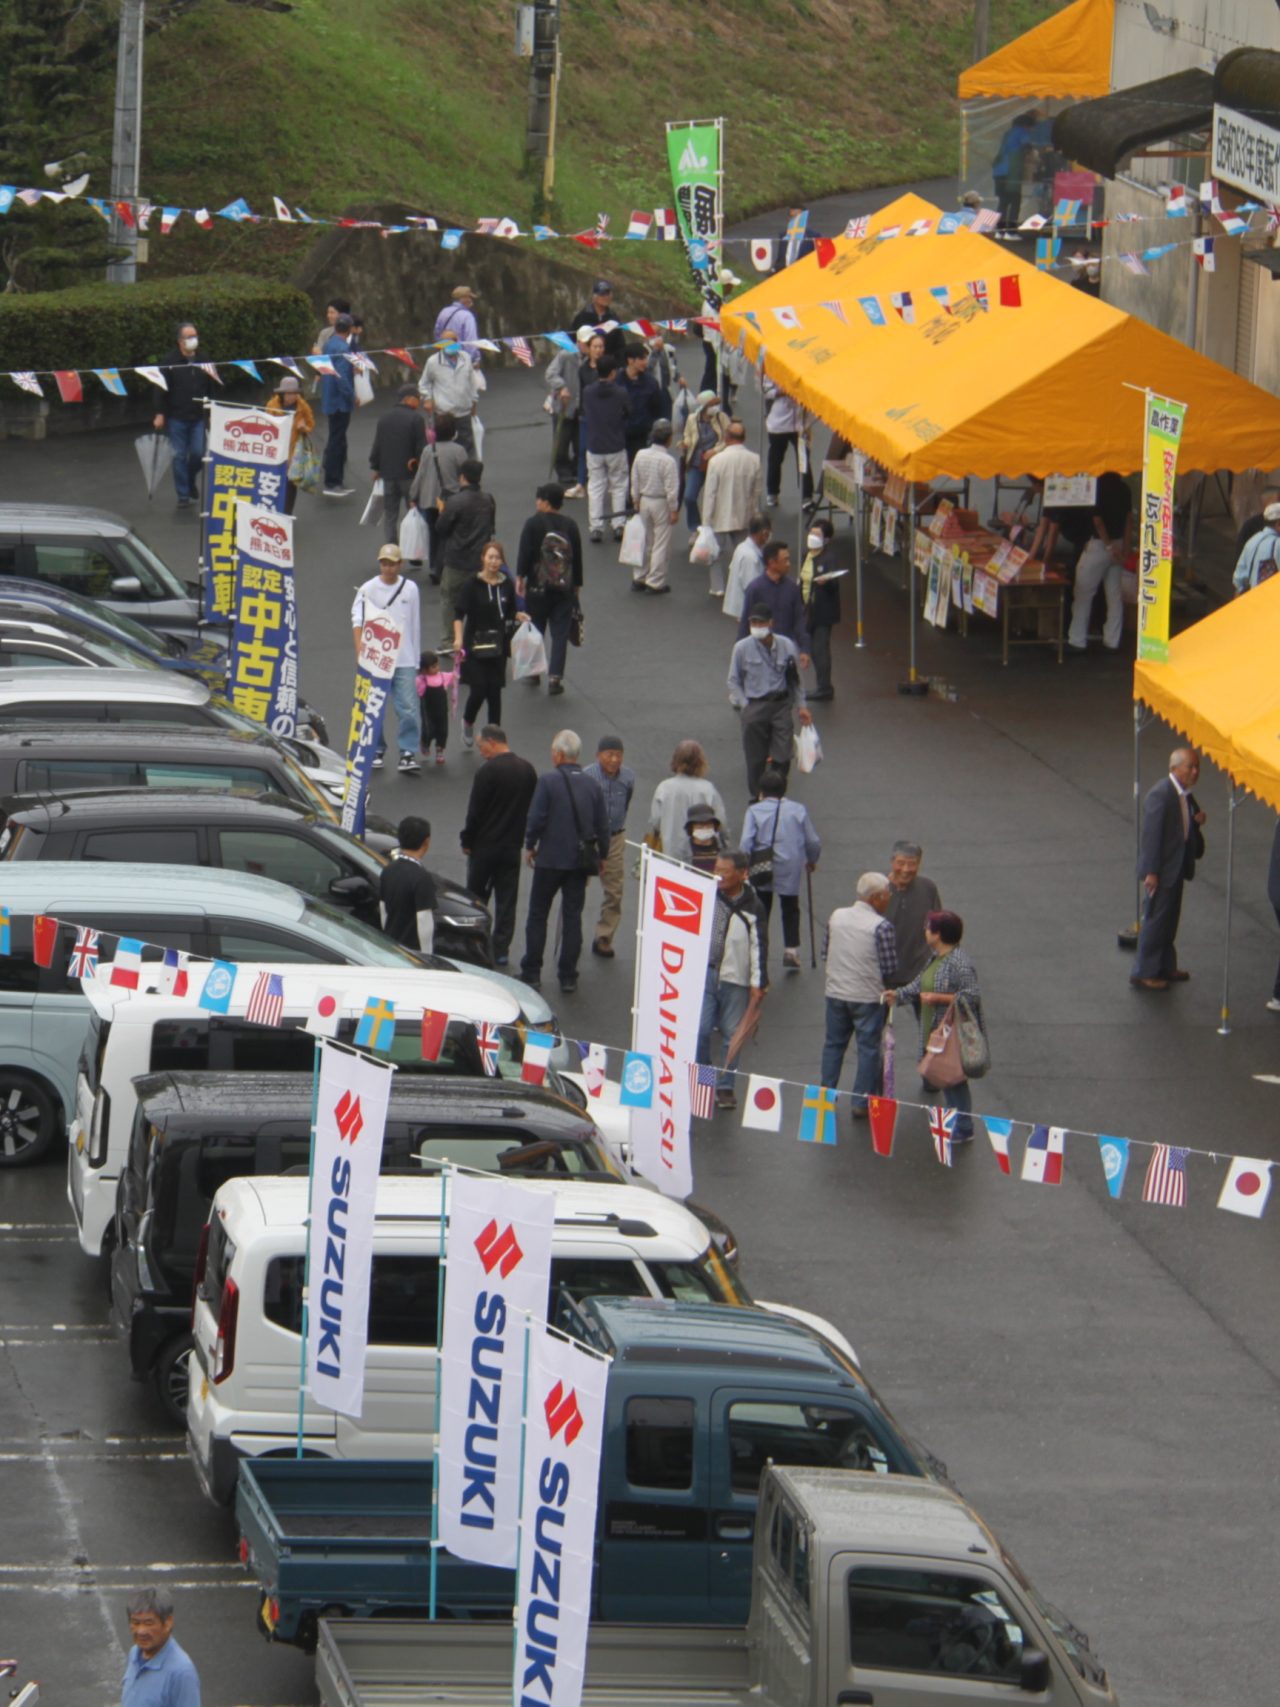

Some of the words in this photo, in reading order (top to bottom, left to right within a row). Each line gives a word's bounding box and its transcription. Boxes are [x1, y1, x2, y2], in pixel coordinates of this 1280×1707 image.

[213, 463, 256, 489] 認定
[222, 437, 278, 461] 熊本日産
[240, 562, 284, 595] 認定
[270, 574, 298, 739] 安心と信頼の
[658, 941, 685, 1170] DAIHATSU
[316, 1155, 352, 1380] SUZUKI
[460, 1289, 507, 1531] SUZUKI
